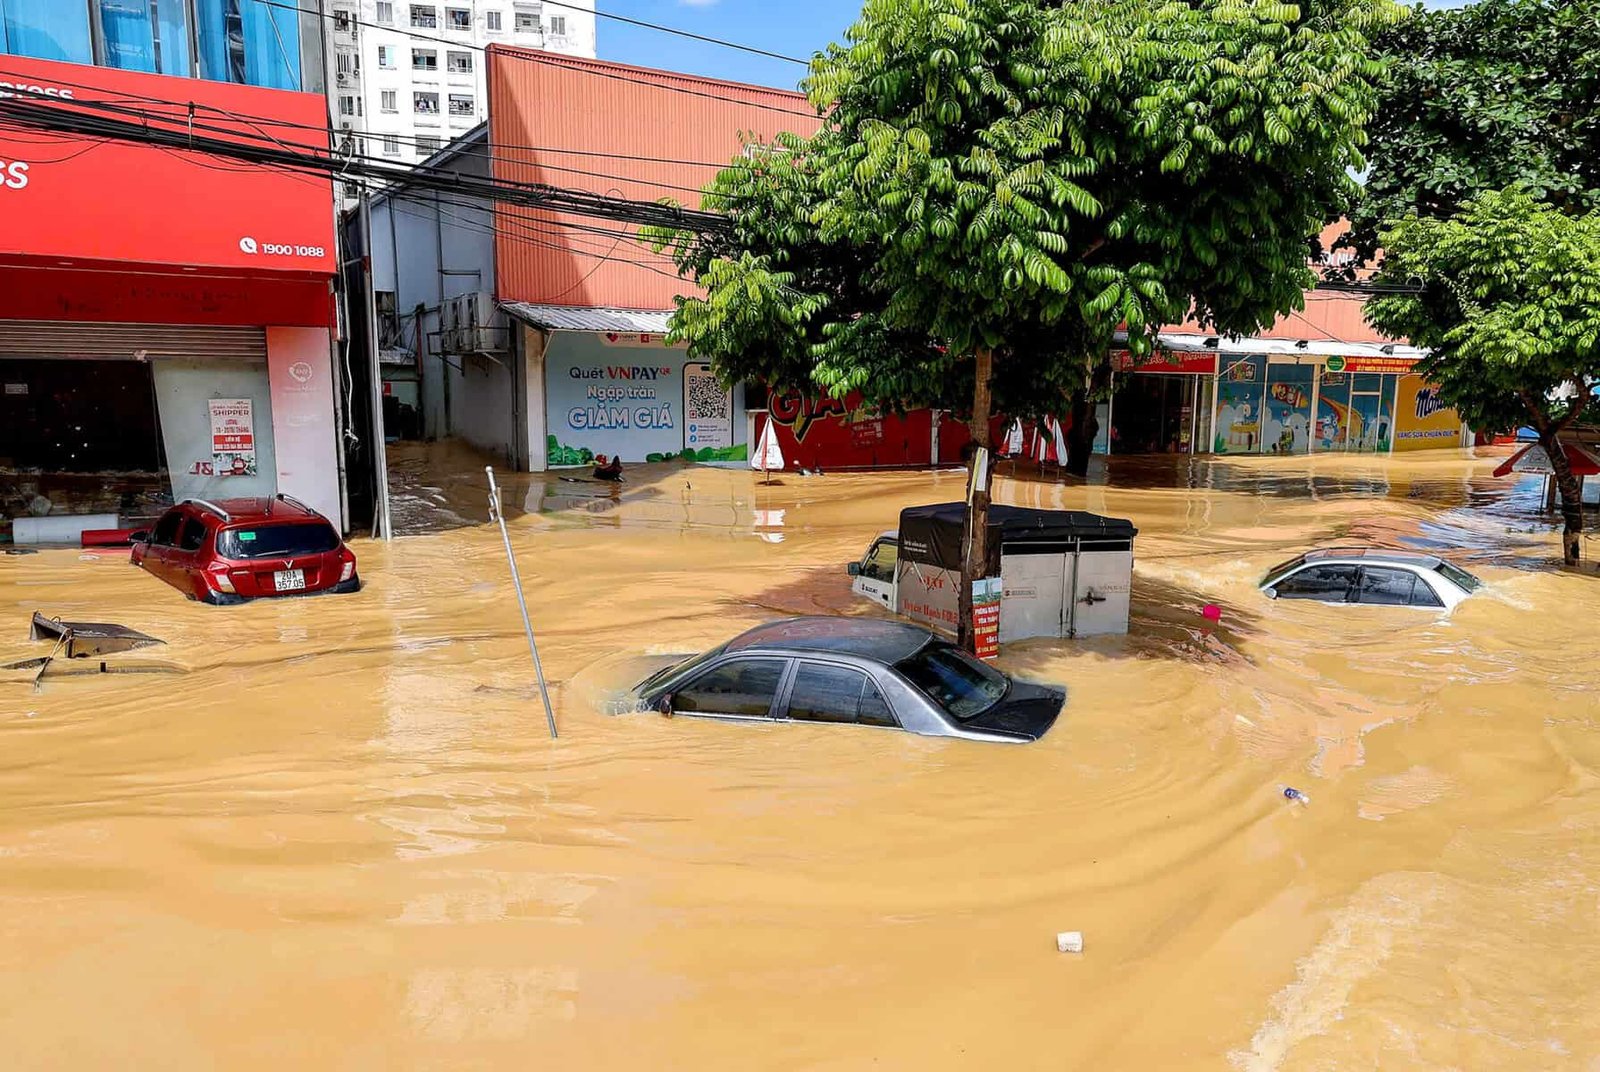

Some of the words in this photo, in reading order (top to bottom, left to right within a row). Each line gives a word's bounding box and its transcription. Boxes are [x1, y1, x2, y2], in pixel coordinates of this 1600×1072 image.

[262, 242, 292, 256] 1900
[295, 243, 325, 257] 1088
[569, 366, 604, 380] Quét
[587, 385, 624, 402] Ngập
[627, 386, 656, 399] tràn
[568, 404, 630, 430] GIẢM
[633, 402, 674, 430] GIÁ
[282, 571, 297, 580] 20A
[277, 579, 305, 589] 357.05
